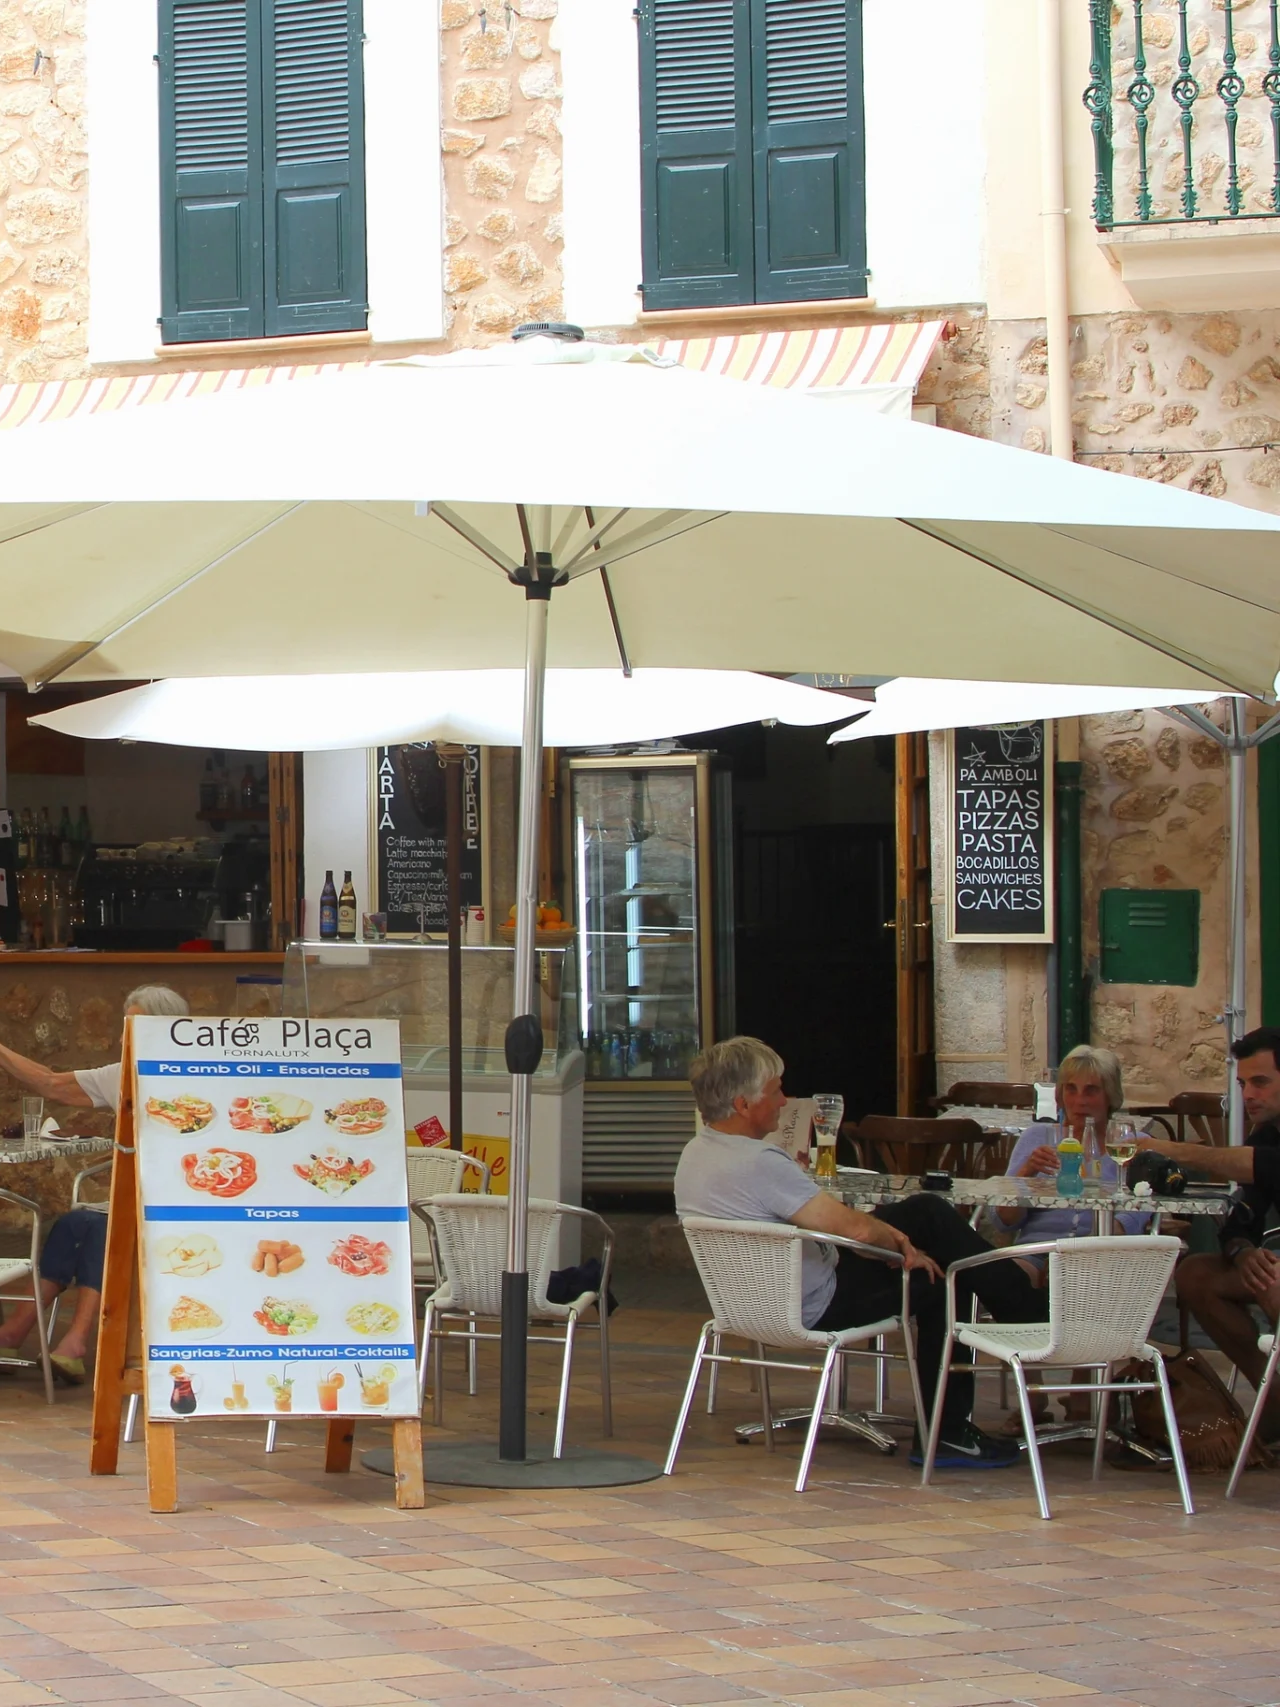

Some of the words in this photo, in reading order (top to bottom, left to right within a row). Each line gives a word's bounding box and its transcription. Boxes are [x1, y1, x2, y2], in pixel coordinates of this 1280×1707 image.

[960, 769, 977, 781] PA
[982, 769, 1014, 781] AMB
[1016, 769, 1037, 781] OLI
[957, 790, 1040, 810] TAPAS
[959, 811, 1039, 830] PIZZAS
[387, 836, 416, 847] Coffee
[418, 837, 434, 847] with
[962, 833, 1037, 853] PASTA
[387, 848, 408, 858] Latte
[387, 858, 431, 868] Americano
[957, 856, 1039, 869] BOCADILLOS
[956, 872, 1042, 885] SANDWICHES
[388, 880, 448, 892] Espresso/cort
[957, 889, 1042, 910] CAKES
[170, 1018, 250, 1047] Café
[282, 1019, 372, 1056] Plaça
[224, 1049, 310, 1057] FORNALUTX
[159, 1064, 181, 1073] Pa
[187, 1064, 231, 1074] amb
[236, 1064, 260, 1074] Oli
[279, 1065, 370, 1075] Ensaladas
[245, 1208, 300, 1219] Tapas
[150, 1348, 273, 1359] Sangrias-Zumo
[278, 1347, 409, 1357] Natural-Coktails
